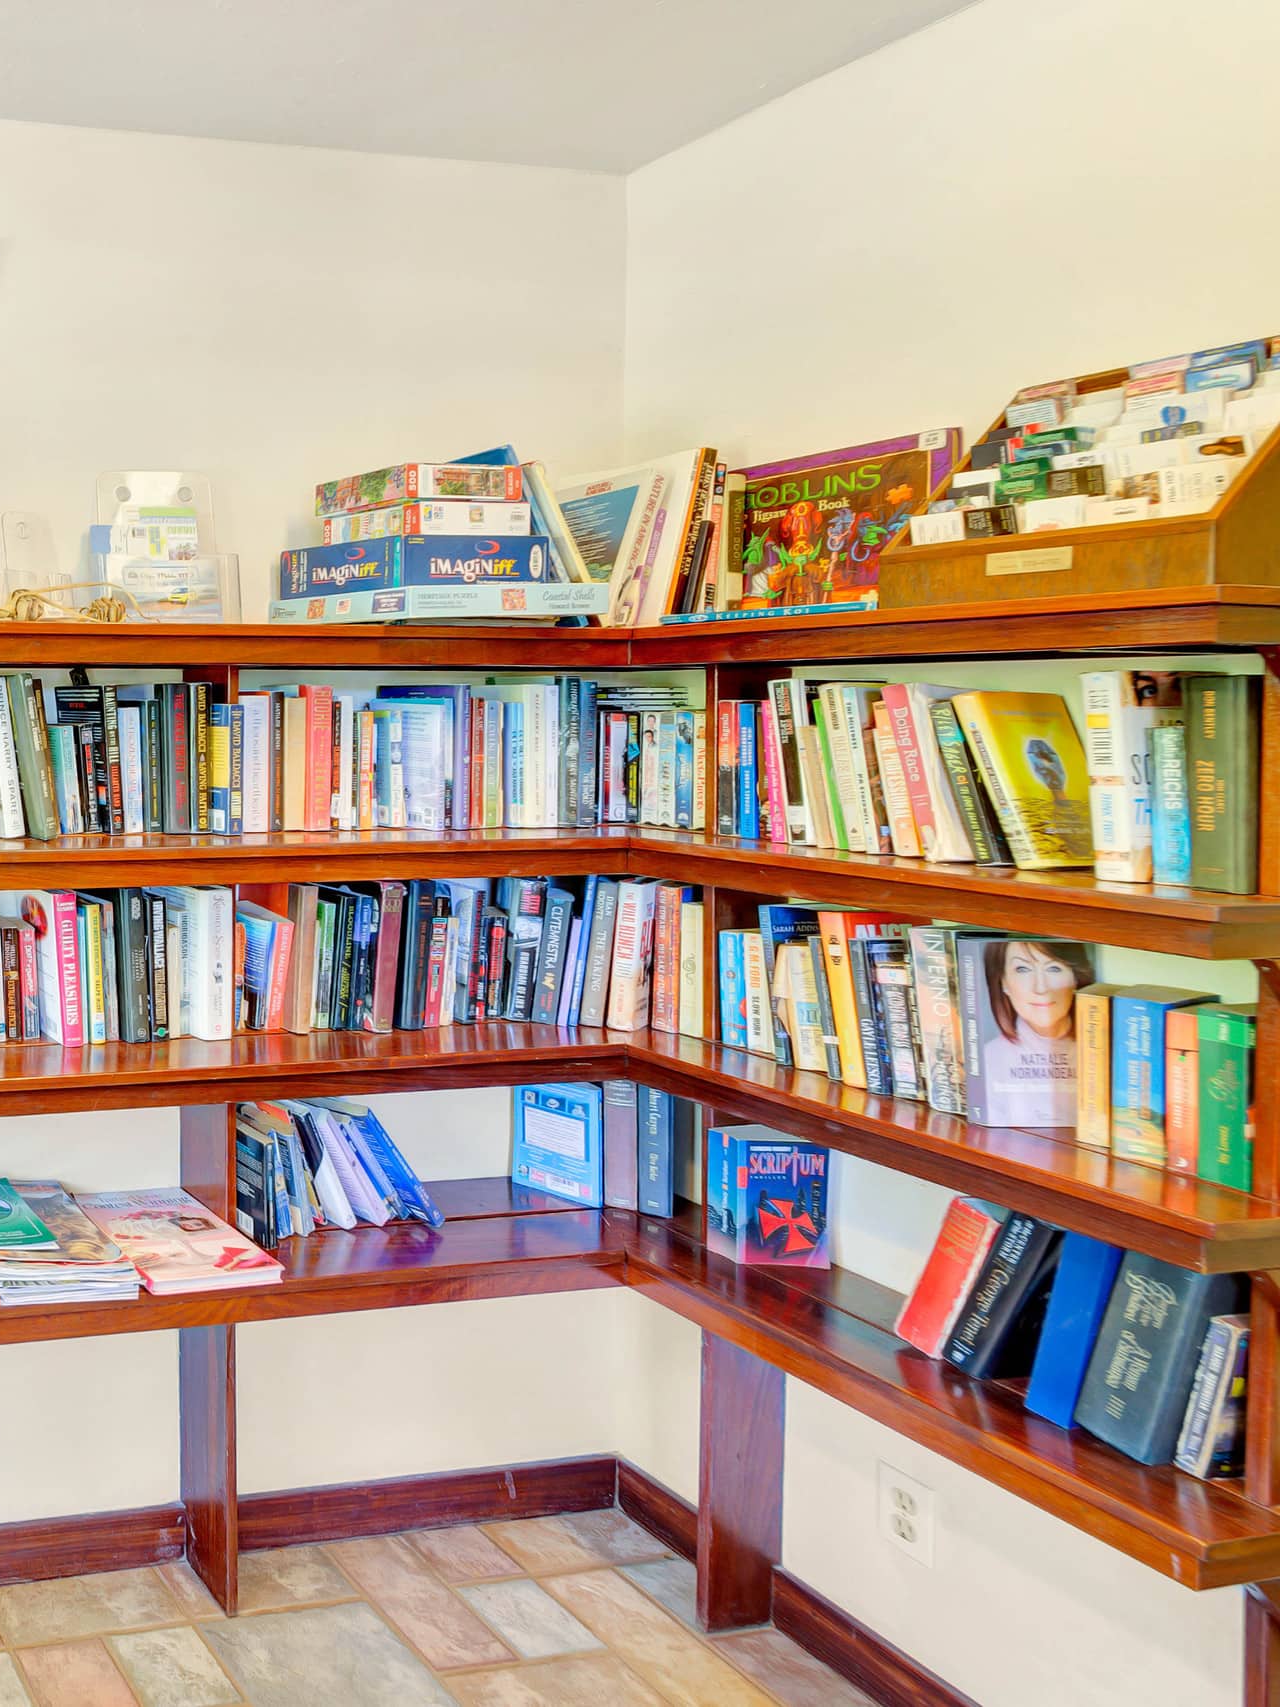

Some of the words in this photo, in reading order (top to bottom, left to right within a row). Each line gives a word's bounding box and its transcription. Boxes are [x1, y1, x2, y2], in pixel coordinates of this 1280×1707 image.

[752, 509, 788, 524] Jigsaw
[818, 497, 851, 512] Book
[105, 692, 118, 730] HAUNTING
[198, 686, 208, 711] DAVID
[198, 713, 208, 753] BALDACCI
[232, 720, 242, 746] DAVID
[932, 708, 958, 737] RILEY
[1202, 708, 1216, 739] BENTLEY
[110, 747, 120, 764] HILL
[892, 707, 913, 747] Doing
[904, 748, 922, 782] Race
[942, 741, 967, 774] SAGER
[1, 733, 13, 771] HARRY
[7, 779, 18, 816] SPARE
[198, 762, 208, 791] SAVING
[232, 748, 242, 788] BALDACCI
[1196, 760, 1215, 792] ZERO
[882, 753, 911, 818] PROFESSIONAL
[1162, 759, 1183, 810] REICHS
[199, 792, 208, 817] FAITH
[1196, 796, 1216, 832] HOUR
[152, 900, 164, 931] IRVING
[596, 890, 606, 920] KOONTZ
[605, 896, 614, 916] DEAN
[622, 902, 637, 925] WILD
[61, 919, 75, 961] GUILTY
[280, 926, 289, 951] SUSAN
[344, 906, 354, 960] BLOODLINE
[544, 906, 564, 969] CLYTEMNESTRA
[596, 930, 607, 951] THE
[616, 925, 636, 960] BUNCH
[518, 952, 530, 986] GUARDIAN
[591, 954, 604, 992] TAKING
[750, 966, 760, 988] FORD
[924, 933, 951, 1018] INFERNO
[8, 980, 16, 1005] EXTREME
[62, 963, 79, 1026] PLEASURES
[515, 994, 526, 1009] LIES
[656, 982, 666, 1013] DREAMS
[752, 996, 760, 1015] SLOW
[752, 1017, 761, 1036] BURN
[860, 1018, 878, 1050] GAYLE
[864, 1052, 882, 1088] LEESON
[1020, 1053, 1069, 1066] NATHALIE
[750, 1148, 825, 1180] SCRIPTUM
[976, 1268, 1010, 1312] George
[959, 1312, 992, 1346] Tenet
